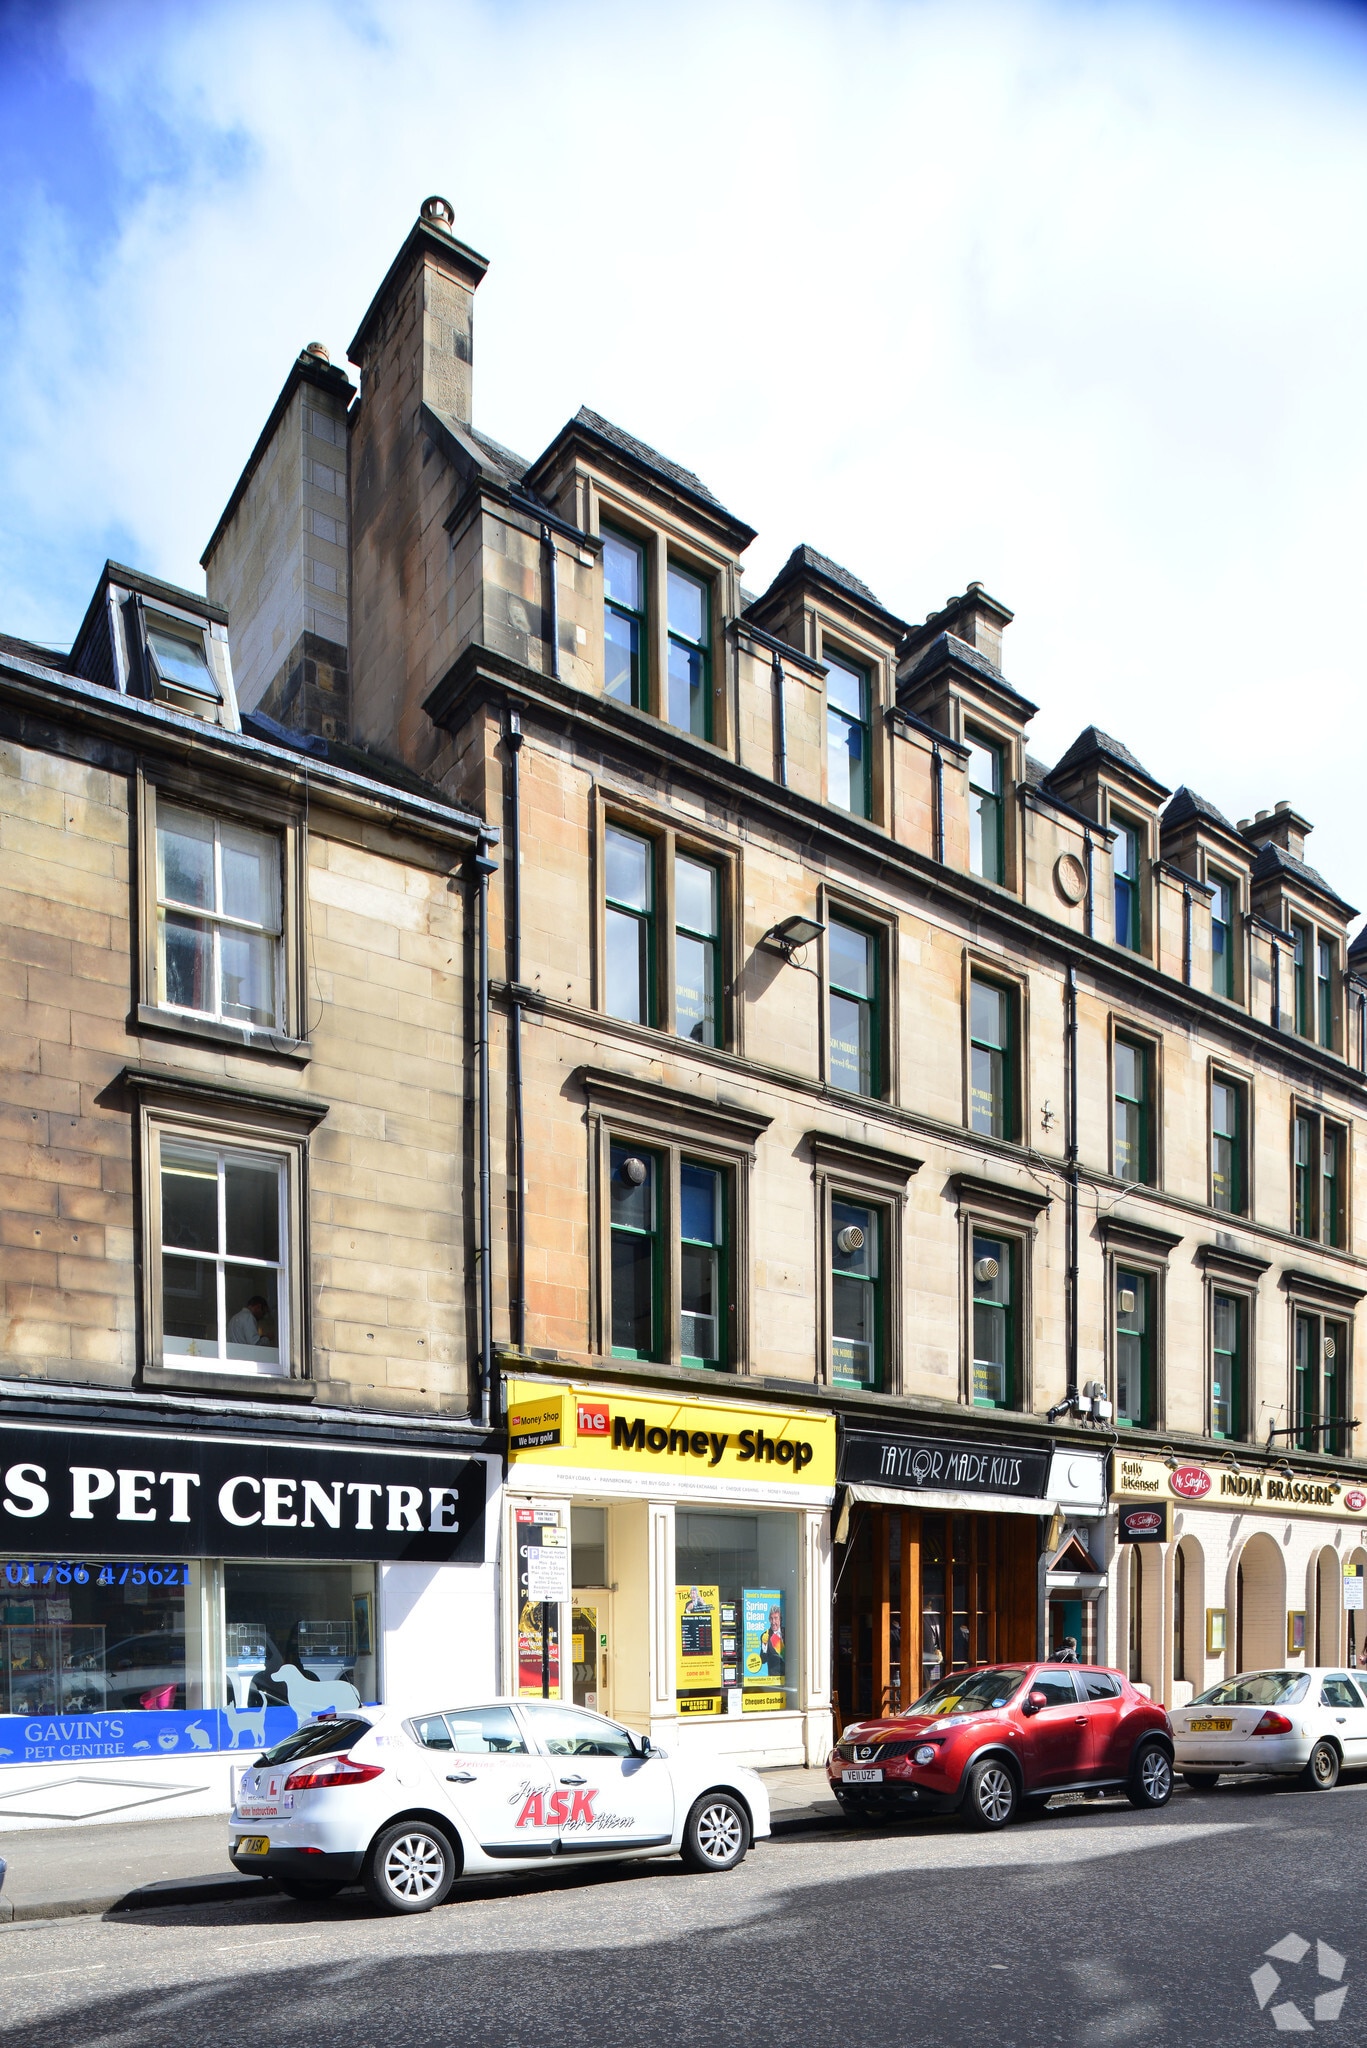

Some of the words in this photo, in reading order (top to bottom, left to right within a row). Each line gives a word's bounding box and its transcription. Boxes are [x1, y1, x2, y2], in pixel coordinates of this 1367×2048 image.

[521, 1415, 541, 1426] Money
[543, 1412, 559, 1422] Shop
[518, 1436, 527, 1446] We
[528, 1435, 539, 1446] buy
[540, 1432, 553, 1444] gold
[577, 1407, 605, 1429] he
[614, 1415, 729, 1464] Money
[738, 1429, 814, 1471] Shop
[880, 1446, 943, 1479] TAYLOR
[945, 1453, 989, 1482] MADE
[989, 1457, 1022, 1486] KILTS
[1122, 1462, 1143, 1476] Fully
[1122, 1476, 1159, 1491] Licensed
[1221, 1474, 1263, 1498] INDIA
[1267, 1480, 1335, 1506] BRASSERIE
[69, 1466, 201, 1523] PET
[217, 1475, 460, 1533] CENTRE
[5, 1560, 90, 1585] 01786
[99, 1562, 193, 1586] 475621
[678, 1592, 691, 1601] Tick
[699, 1589, 714, 1597] Tock
[746, 1601, 768, 1611] Spring
[746, 1611, 765, 1621] Clean
[746, 1621, 765, 1631] Deals
[744, 1698, 766, 1706] Cheques
[24, 1720, 125, 1742] GAVIN'S
[24, 1746, 56, 1759] PET
[59, 1742, 125, 1757] CENTRE
[847, 1771, 861, 1780] VE11
[861, 1770, 876, 1780] UZF
[269, 1780, 277, 1796] L
[508, 1780, 551, 1805] Just
[251, 1806, 277, 1816] Instruction
[515, 1788, 600, 1828] ASK
